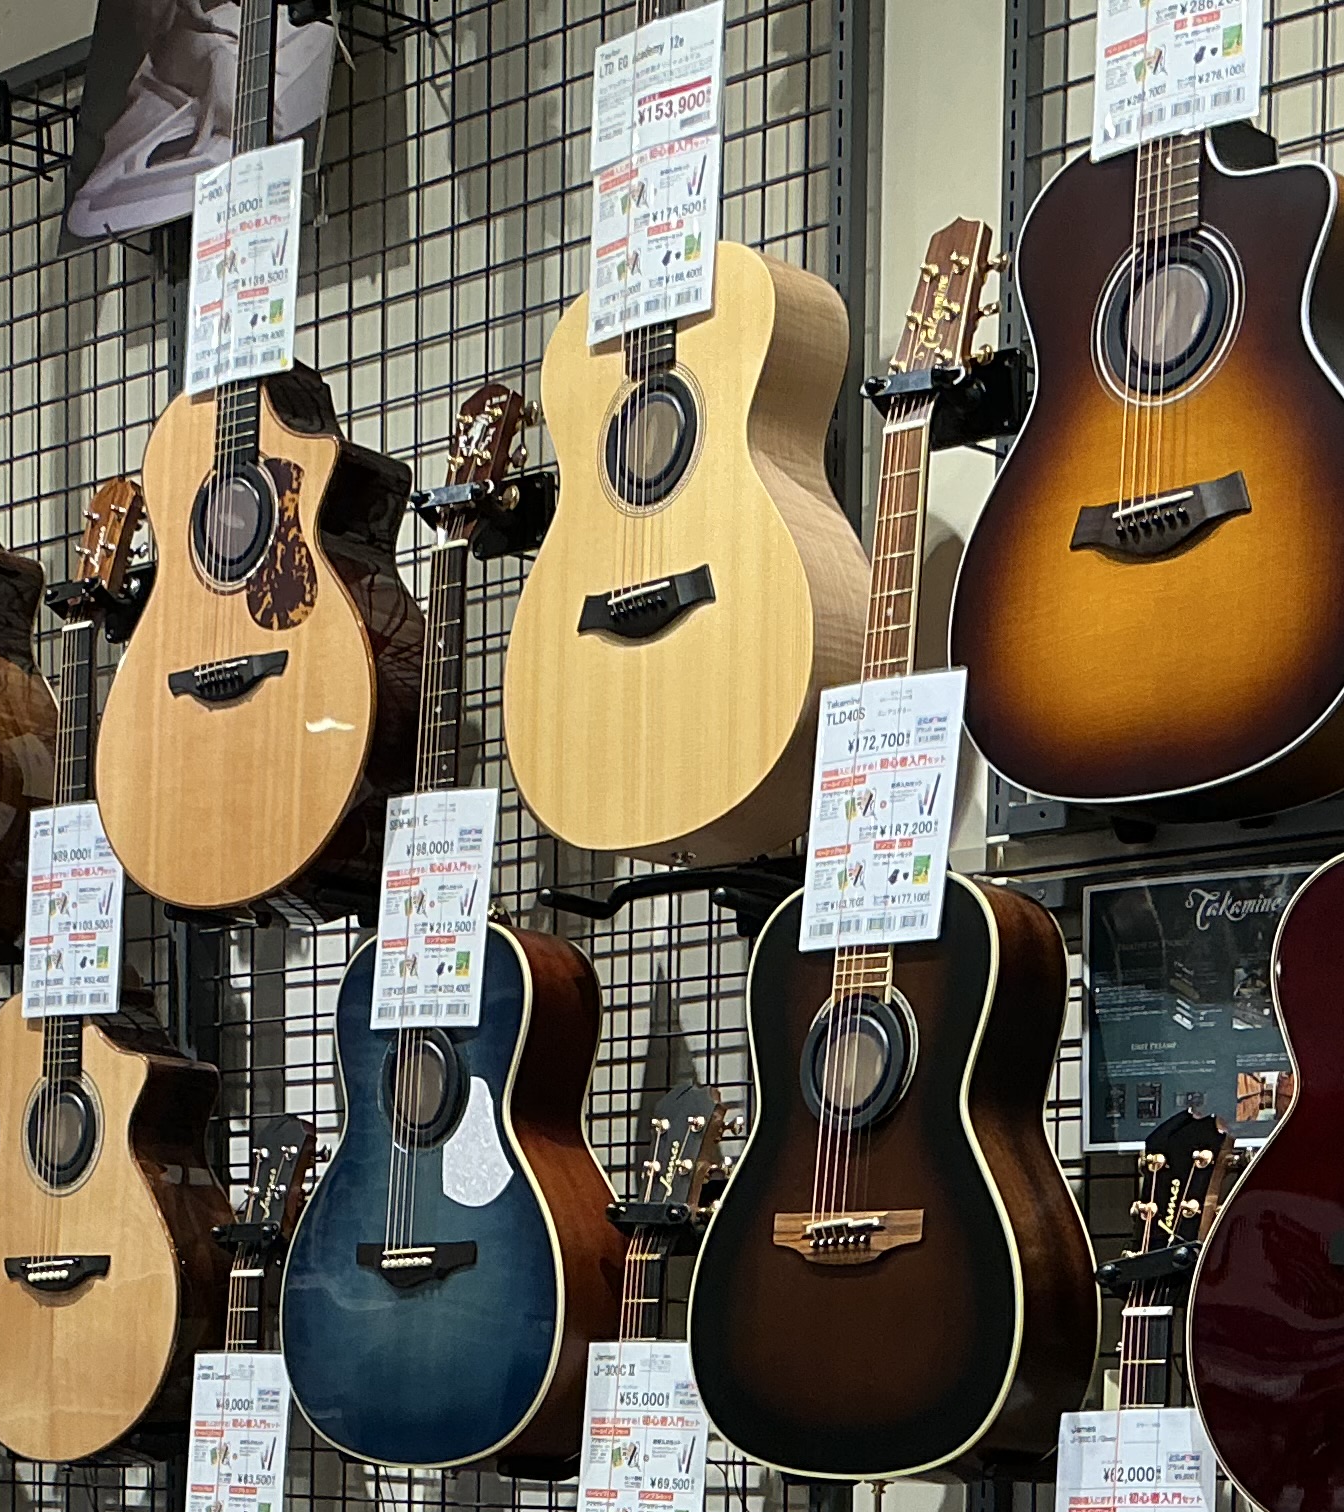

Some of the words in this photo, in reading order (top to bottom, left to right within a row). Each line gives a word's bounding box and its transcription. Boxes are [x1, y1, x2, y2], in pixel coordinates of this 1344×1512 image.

[637, 89, 705, 126] ¥153,900
[1185, 888, 1285, 931] Takamine
[619, 1391, 665, 1408] ¥55,000
[1103, 1466, 1155, 1484] ¥62,000
